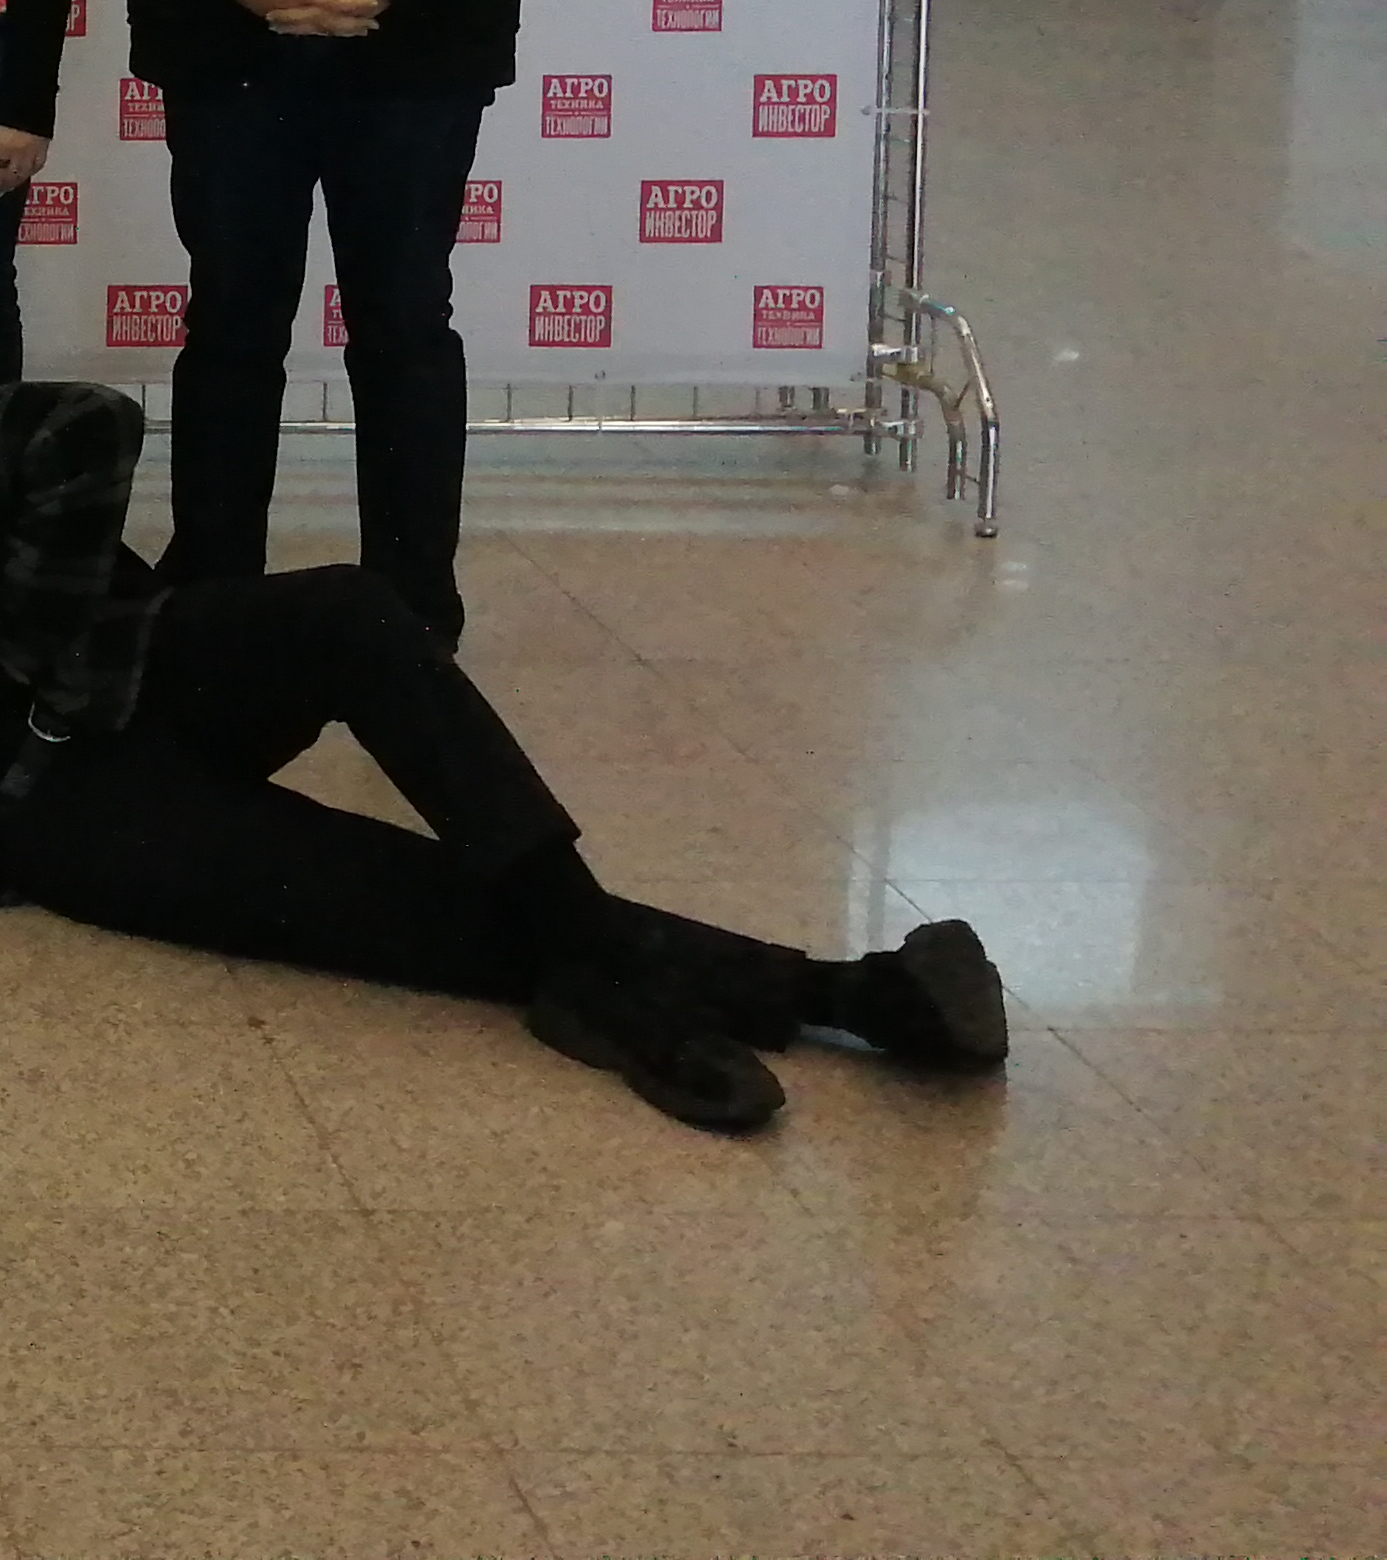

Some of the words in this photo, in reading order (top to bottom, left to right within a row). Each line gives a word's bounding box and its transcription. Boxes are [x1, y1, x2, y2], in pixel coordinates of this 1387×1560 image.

[547, 78, 607, 98] АГРО
[759, 78, 832, 103] АГРО
[758, 104, 830, 135] ИНВЕСТОР
[26, 186, 74, 205] ГРО
[469, 183, 499, 203] РО
[646, 184, 718, 209] АГРО
[645, 210, 716, 241] ИНВЕСТОР
[113, 290, 185, 314] АГРО
[535, 289, 607, 314] АГРО
[758, 289, 819, 309] АГРО
[112, 315, 183, 344] ИНВЕСТОР
[534, 315, 605, 345] ИНВЕСТОР
